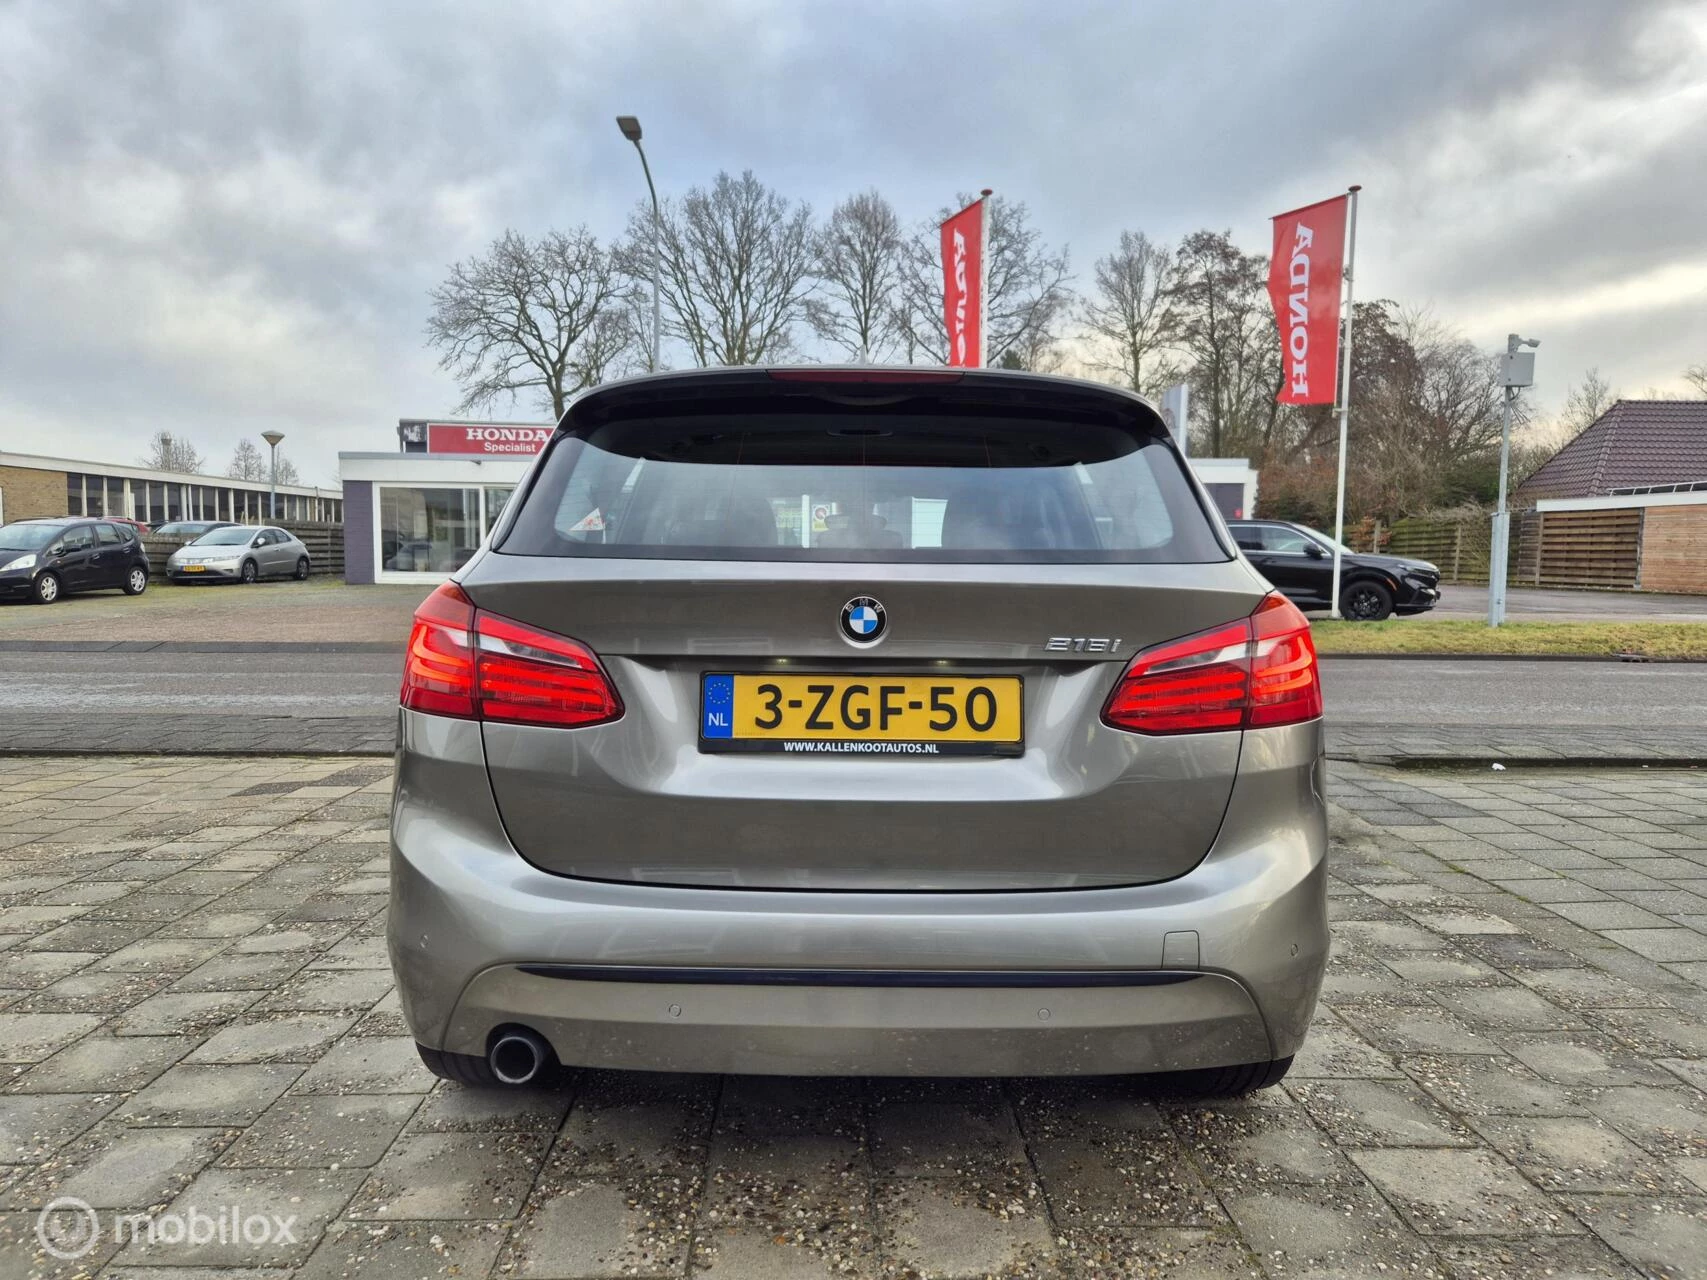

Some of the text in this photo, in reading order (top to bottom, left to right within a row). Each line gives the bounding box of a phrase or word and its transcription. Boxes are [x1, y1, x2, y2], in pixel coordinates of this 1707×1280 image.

[466, 428, 549, 442] HONDA
[484, 442, 536, 453] Specialist
[845, 598, 884, 613] BMW
[1044, 637, 1122, 653] 218i
[754, 684, 997, 732] 3-ZGF-50
[708, 712, 728, 727] NL
[783, 742, 939, 754] WWW.KALLENKOOTAUTOS.NL
